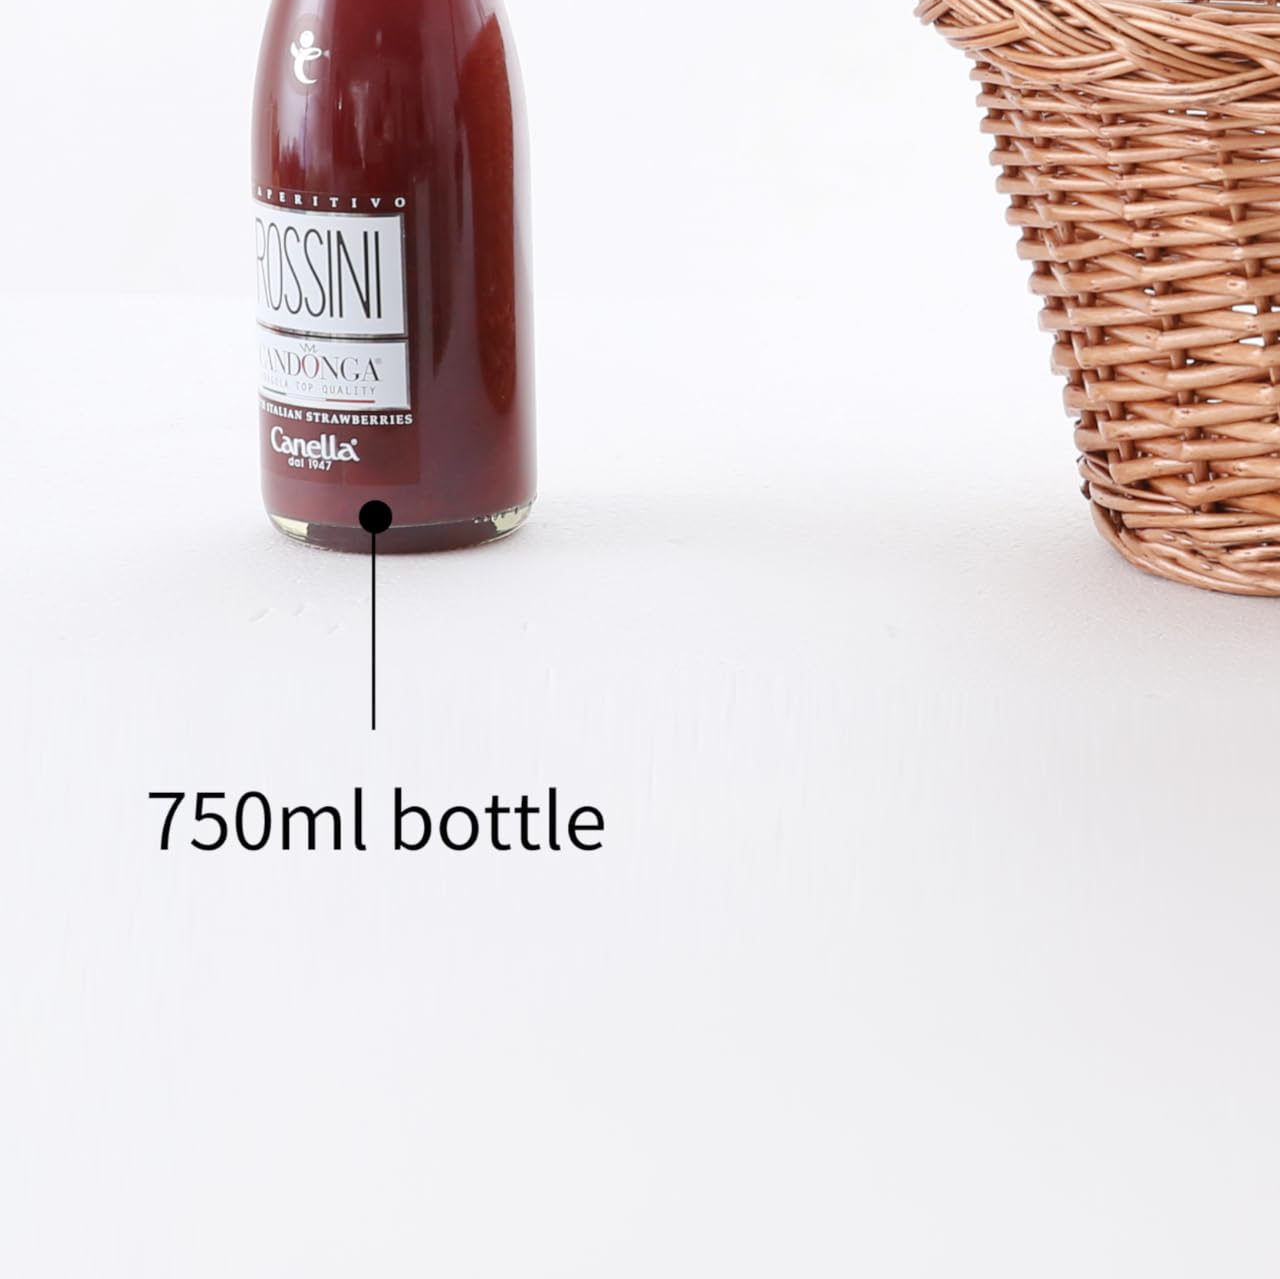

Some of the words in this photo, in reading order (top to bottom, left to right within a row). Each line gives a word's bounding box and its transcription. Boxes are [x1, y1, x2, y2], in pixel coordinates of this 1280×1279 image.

[257, 186, 406, 209] APERITIVO
[256, 215, 383, 319] ROSSINI
[260, 347, 382, 382] ANDONGA
[296, 381, 313, 393] TOP
[322, 385, 376, 396] QUALITY
[266, 402, 302, 421] ITALIAN
[306, 411, 413, 425] STRAWBERRIES
[288, 457, 304, 468] dal
[308, 459, 332, 471] 1947
